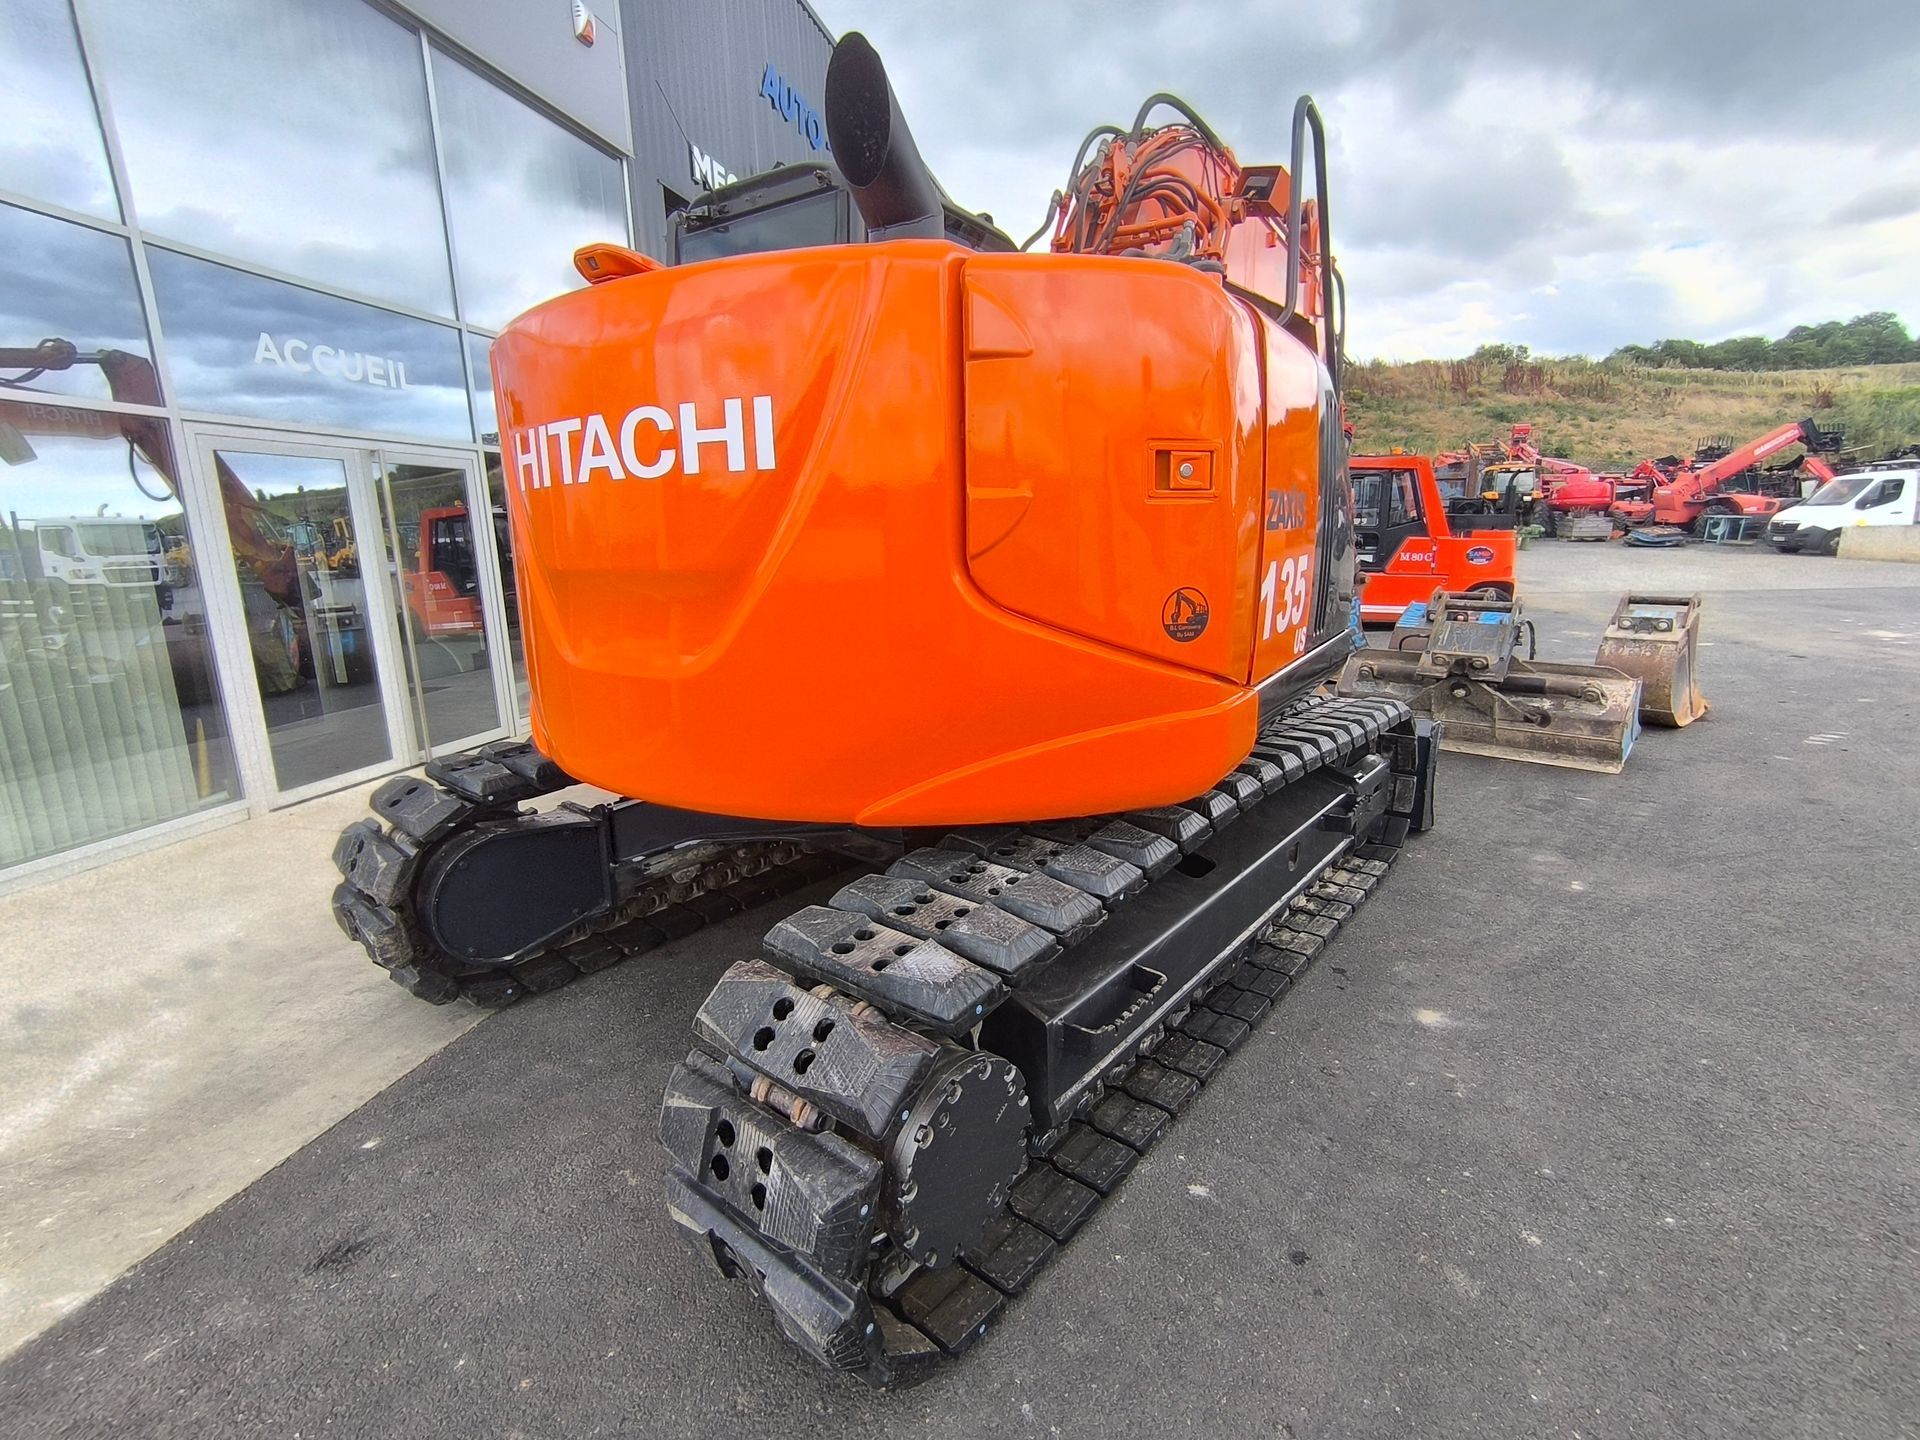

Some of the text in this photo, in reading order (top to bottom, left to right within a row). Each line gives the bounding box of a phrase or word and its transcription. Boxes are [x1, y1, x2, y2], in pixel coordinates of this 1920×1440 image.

[760, 63, 824, 151] AUTO
[254, 332, 416, 390] ACCUEIL
[514, 395, 776, 492] HITACHI
[1400, 553, 1433, 561] M 80 C
[1260, 554, 1308, 641] 135
[1293, 626, 1307, 655] US
